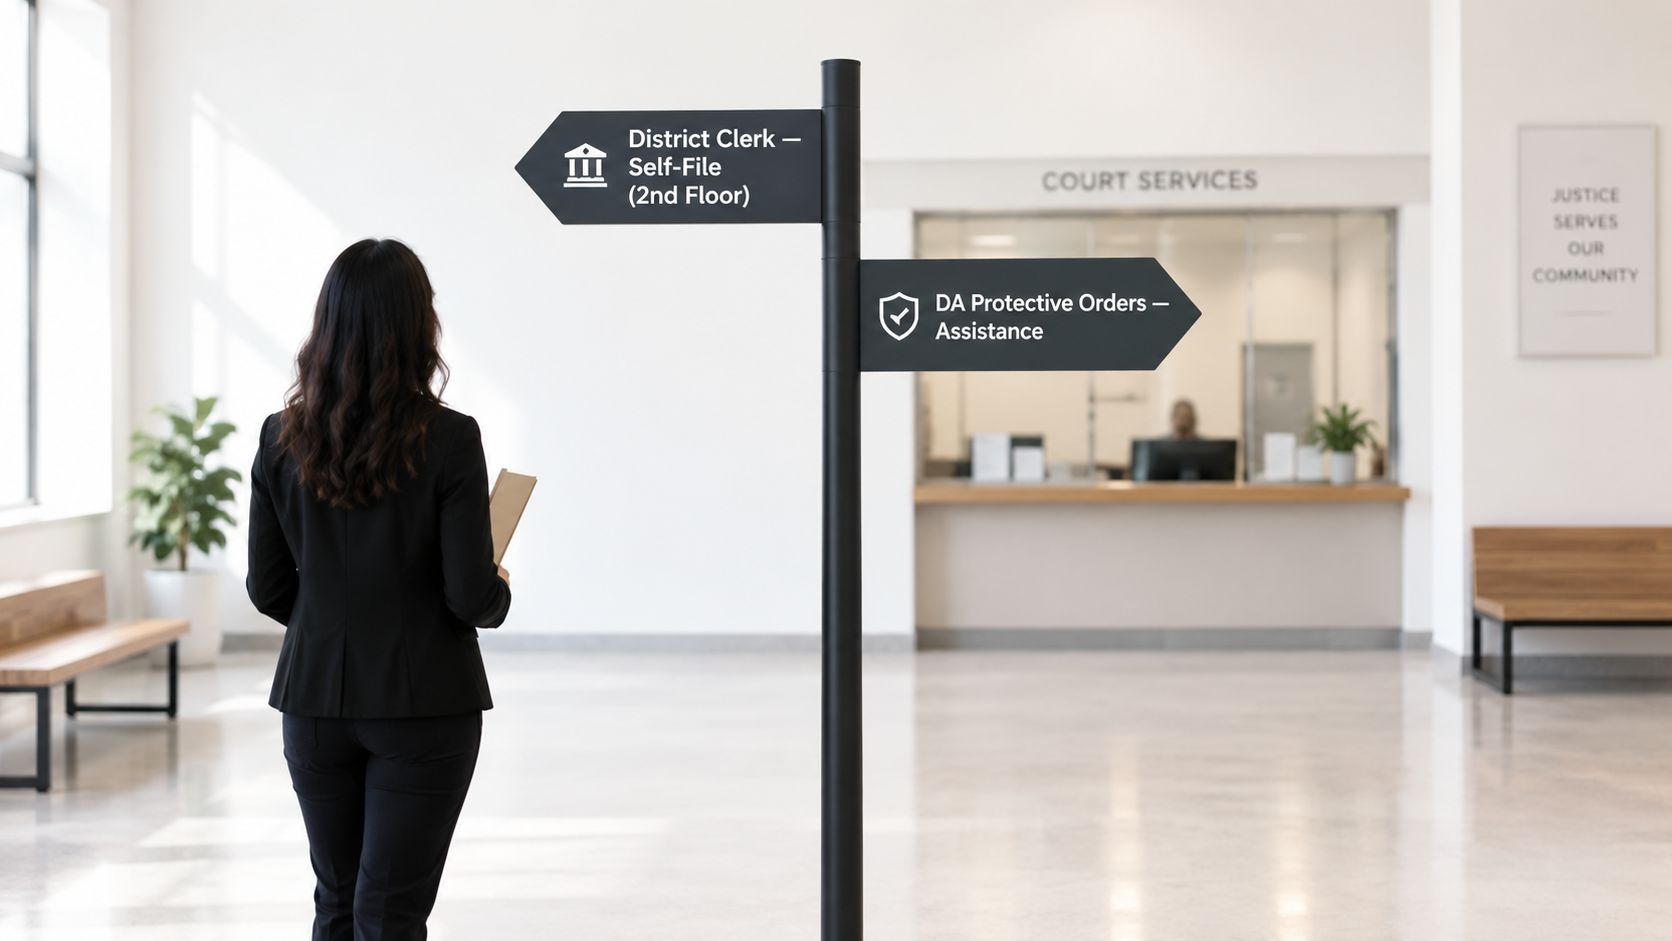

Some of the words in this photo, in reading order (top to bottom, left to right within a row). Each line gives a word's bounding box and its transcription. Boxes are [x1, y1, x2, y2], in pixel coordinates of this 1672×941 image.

[629, 128, 710, 148] District
[716, 128, 775, 148] Clerk
[629, 156, 722, 177] Self-File
[1042, 171, 1129, 191] COURT
[1138, 170, 1258, 191] SERVICES
[628, 185, 678, 209] (2nd
[685, 185, 750, 209] Floor)
[1552, 187, 1620, 203] JUSTICE
[1553, 214, 1619, 230] SERVES
[1567, 241, 1605, 256] OUR
[1533, 267, 1639, 283] COMMUNITY
[935, 293, 967, 312] DA
[971, 293, 1074, 312] Protective
[1078, 293, 1147, 312] Orders
[935, 321, 1044, 341] Assistance
